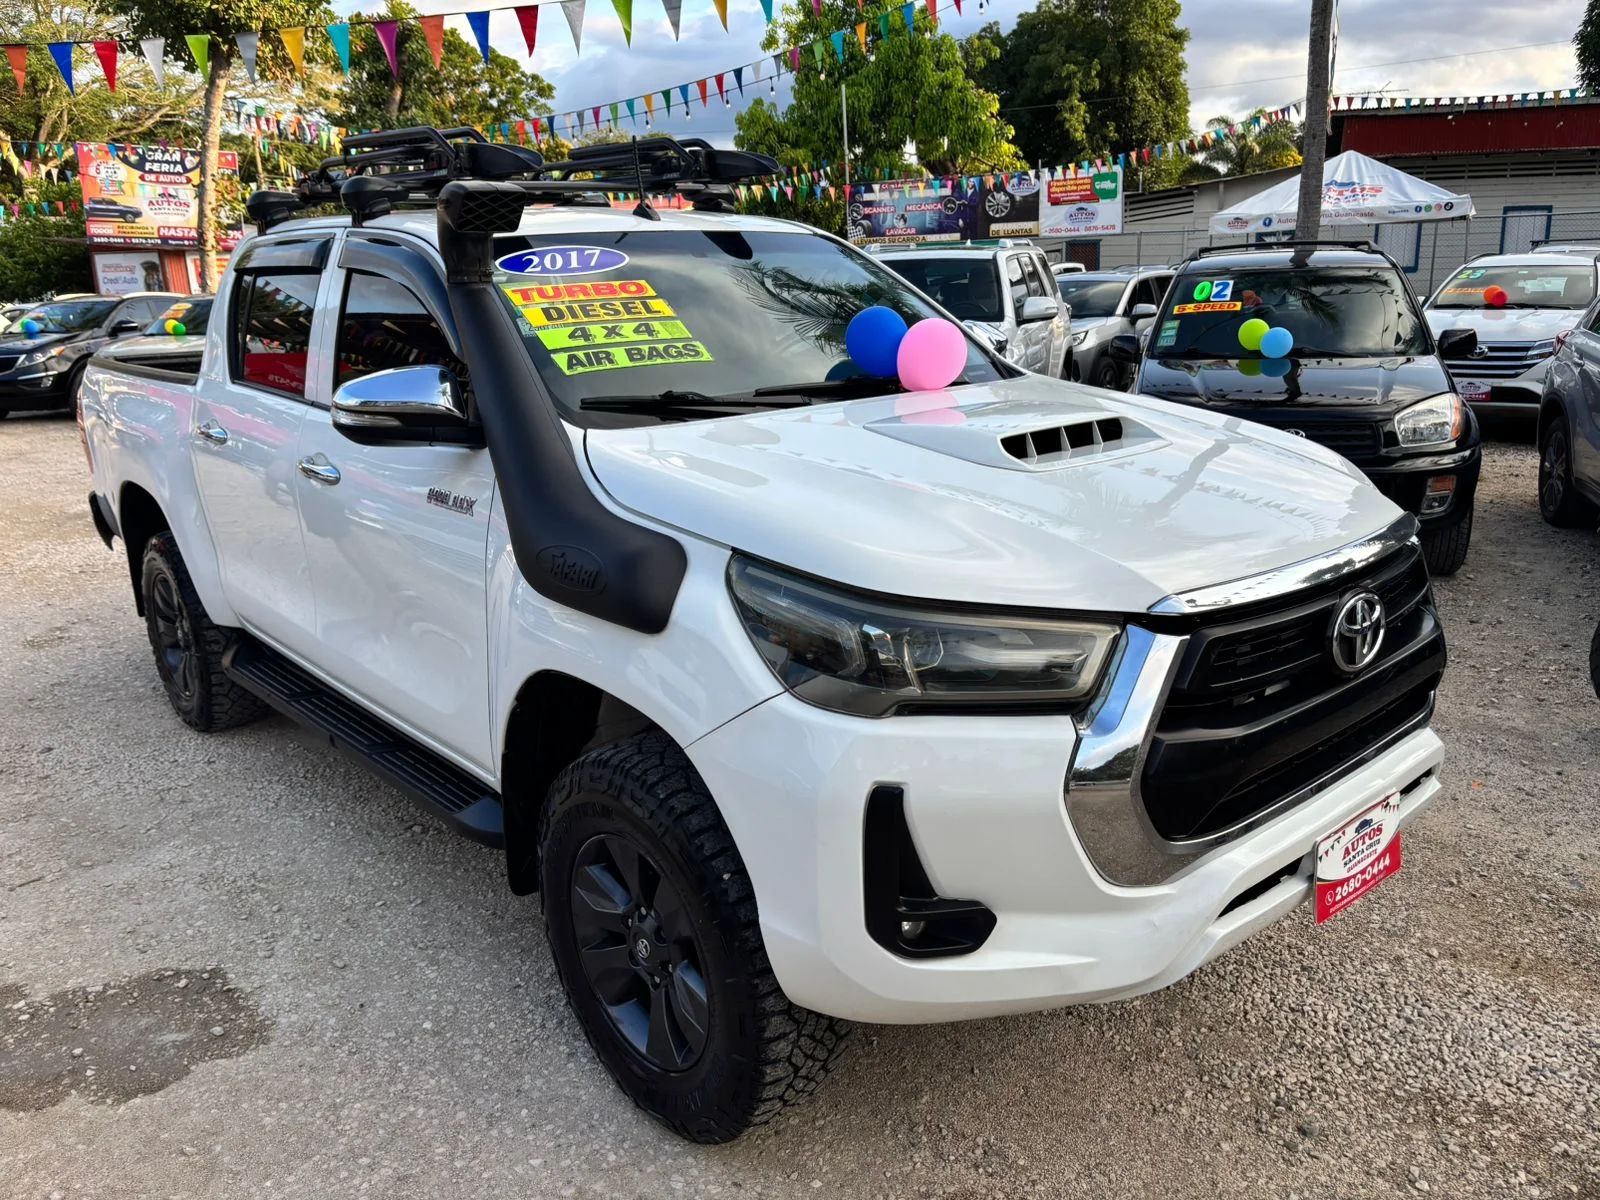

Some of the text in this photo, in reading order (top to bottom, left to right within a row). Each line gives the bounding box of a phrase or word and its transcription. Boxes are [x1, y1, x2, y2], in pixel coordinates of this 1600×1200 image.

[145, 150, 181, 162] GRAN
[145, 162, 184, 173] FERIA
[160, 175, 187, 183] AUTOS
[148, 200, 191, 208] AUTOS
[906, 202, 942, 211] MECÁNICA
[864, 207, 895, 215] SCANNER
[160, 227, 198, 238] HASTA
[886, 227, 916, 235] LAVACAR
[1048, 226, 1080, 234] 2680-0444
[522, 249, 601, 273] 2017
[512, 281, 648, 303] TURBO
[1193, 280, 1231, 301] 02
[542, 300, 665, 323] DIESEL
[1176, 302, 1238, 313] 5-SPEED
[566, 344, 705, 373] AIR BAGS
[1342, 823, 1384, 861] AUTOS
[1343, 838, 1381, 868] SANTA CRUZ
[1346, 848, 1378, 873] GUANACASTE
[1335, 853, 1390, 901] 2680-0444
